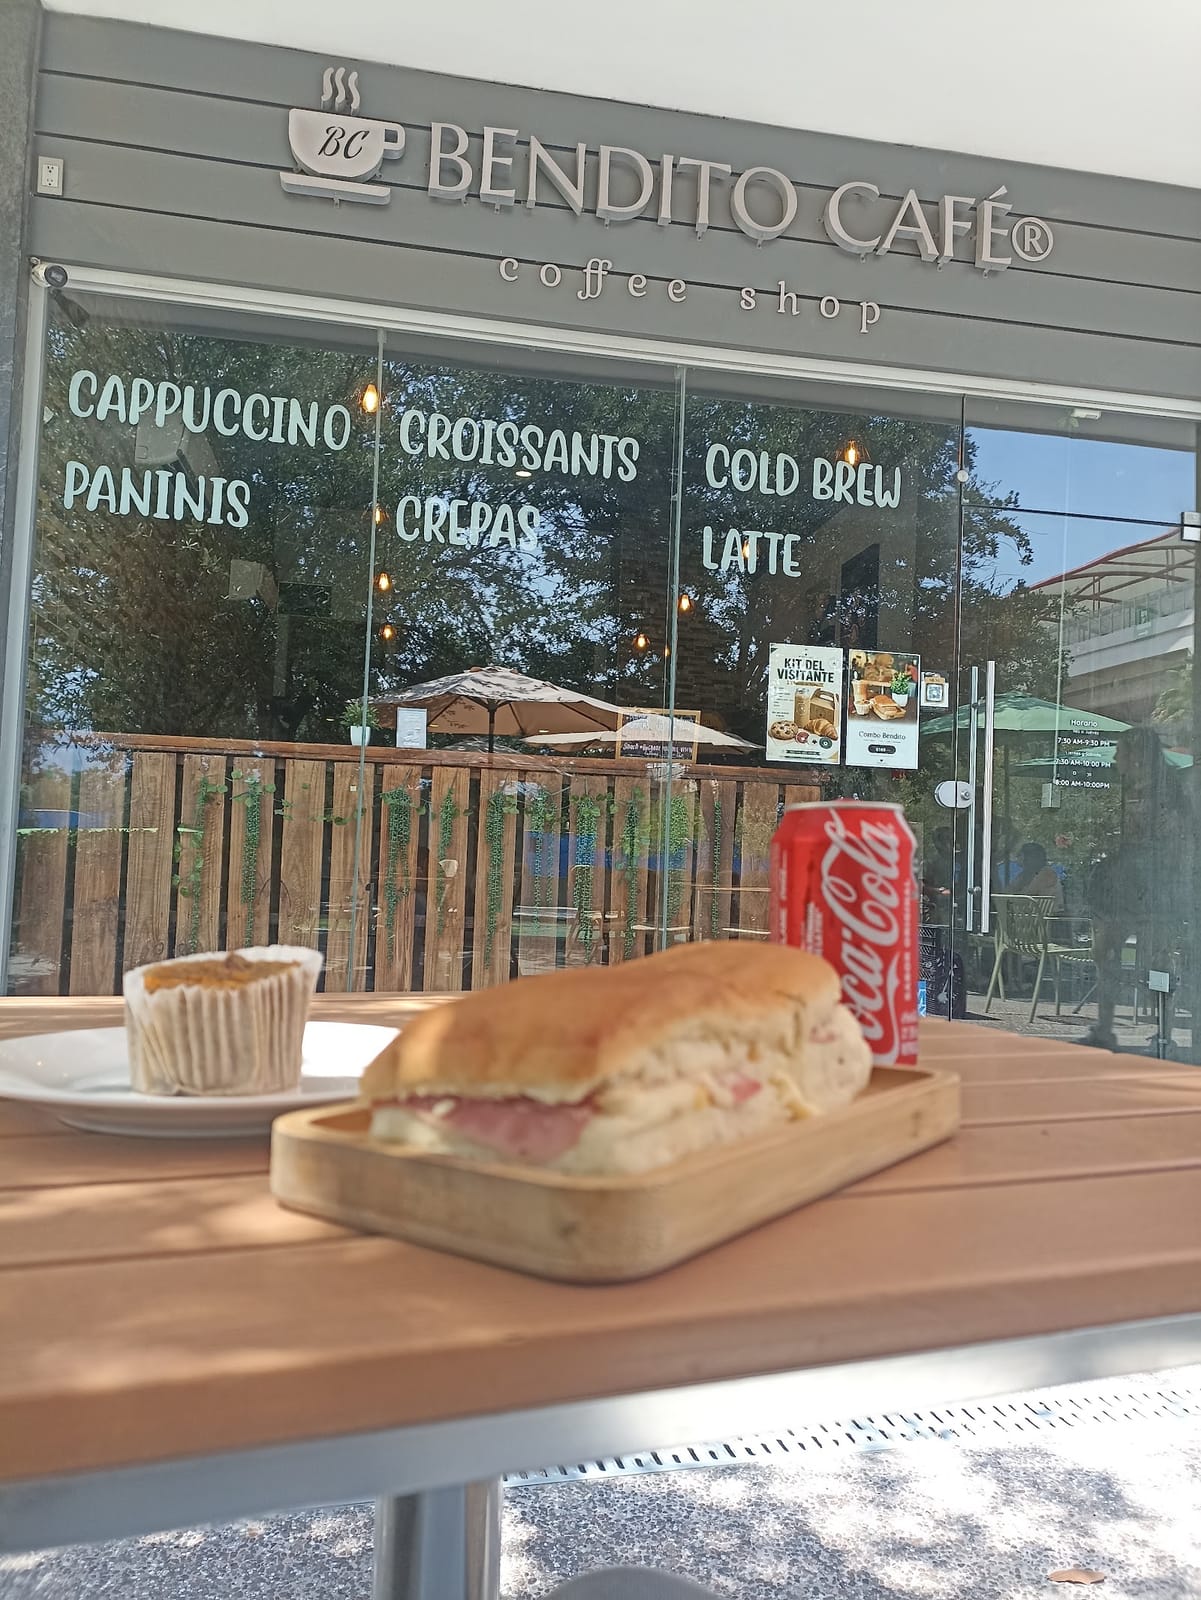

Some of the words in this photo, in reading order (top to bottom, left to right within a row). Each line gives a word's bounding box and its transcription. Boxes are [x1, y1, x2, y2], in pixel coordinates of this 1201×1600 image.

[318, 126, 369, 159] BC
[428, 122, 798, 240] BENDITO
[499, 257, 687, 302] coffee
[740, 280, 881, 333] shop
[68, 370, 351, 451] CAPPUCCINO
[399, 409, 640, 482] CROISSANTS
[63, 460, 250, 528] PANINIS
[705, 443, 800, 497] COLD
[812, 457, 902, 509] BREW
[396, 495, 540, 551] CREPAS
[702, 525, 801, 578] LATTE
[777, 668, 835, 683] VISITANTE
[784, 658, 802, 669] KIT
[805, 659, 825, 671] DEL
[858, 730, 881, 738] Combo
[882, 731, 906, 740] Bendito
[1057, 737, 1072, 745] 7:30
[1071, 719, 1098, 728] Horario
[1055, 779, 1070, 787] 8:00
[820, 808, 900, 1066] oca-Cola
